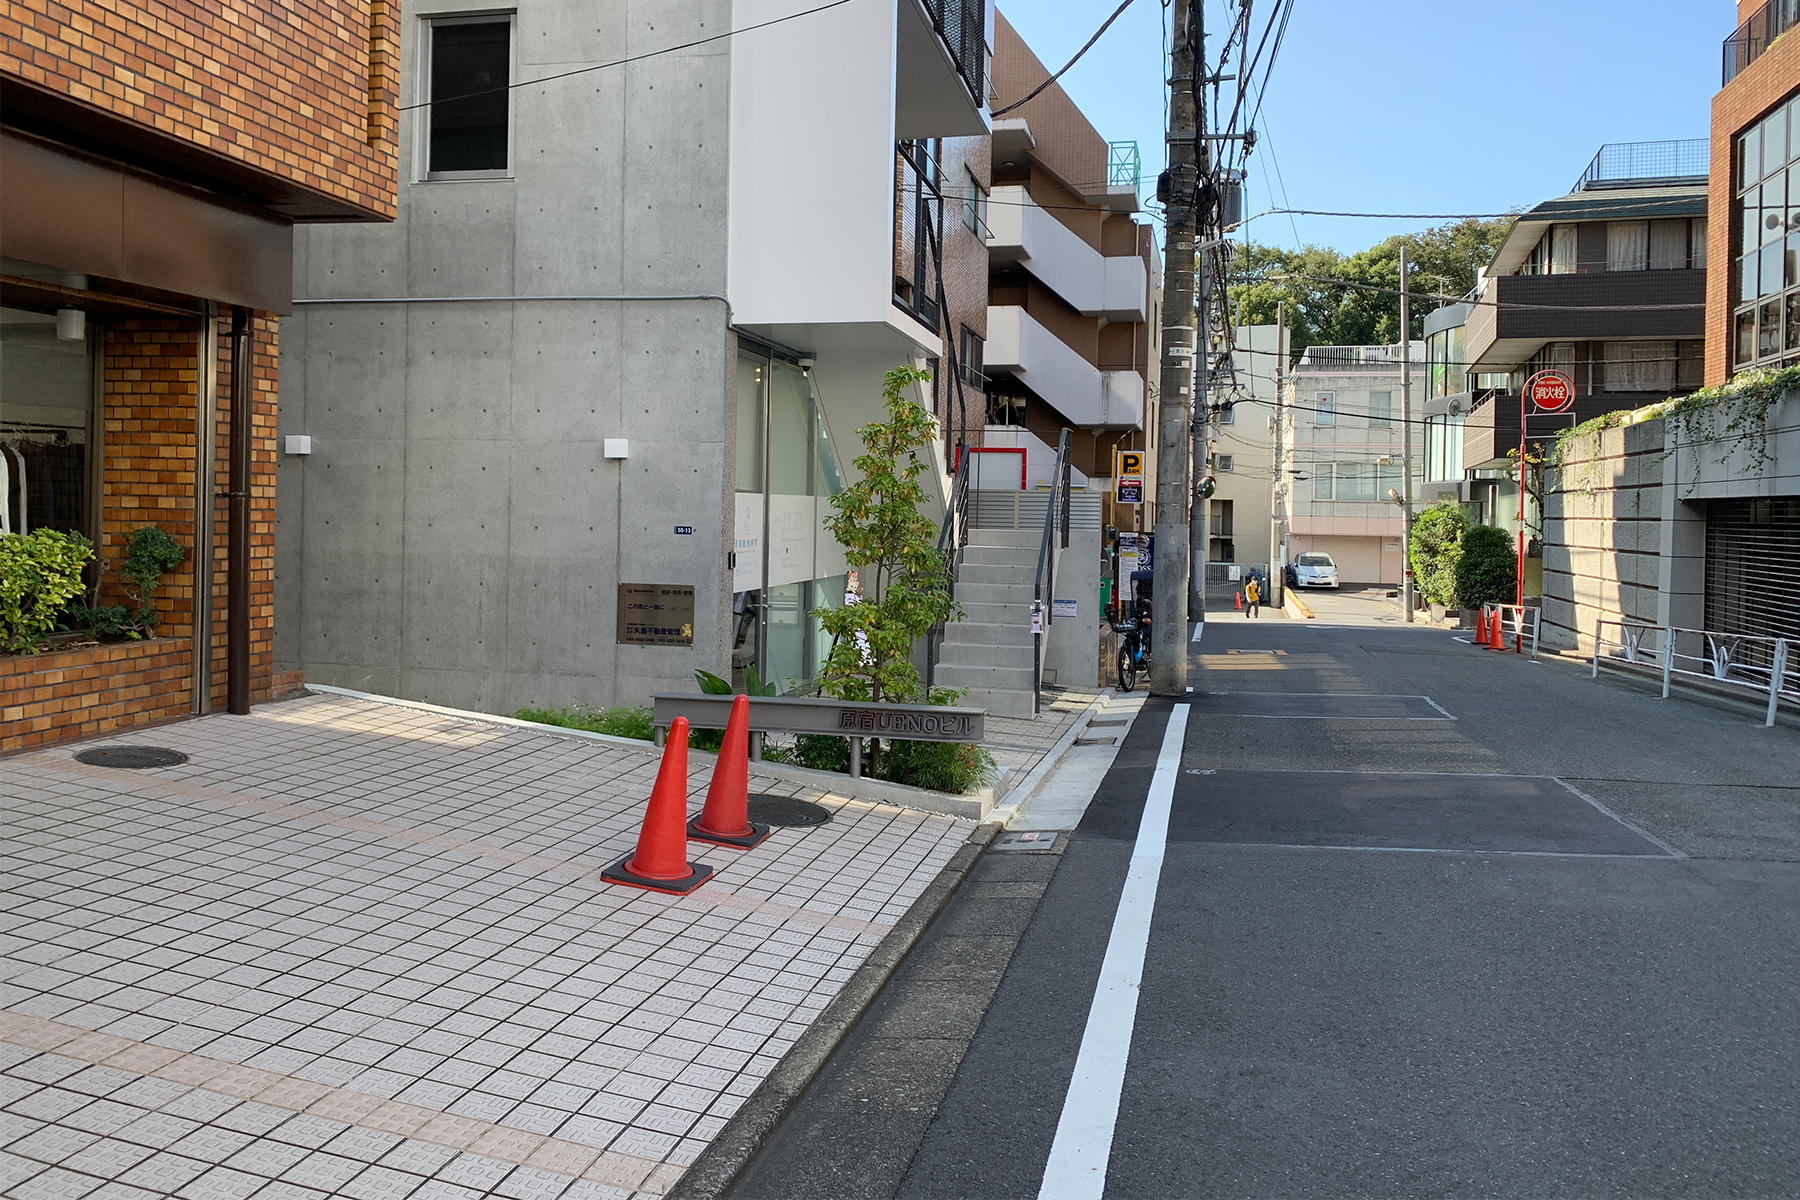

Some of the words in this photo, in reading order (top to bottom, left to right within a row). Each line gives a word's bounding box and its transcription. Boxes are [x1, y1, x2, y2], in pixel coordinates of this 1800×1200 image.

[1535, 386, 1565, 400] 消火栓
[1122, 454, 1140, 474] P
[840, 709, 975, 736] 原宿UENOビル
